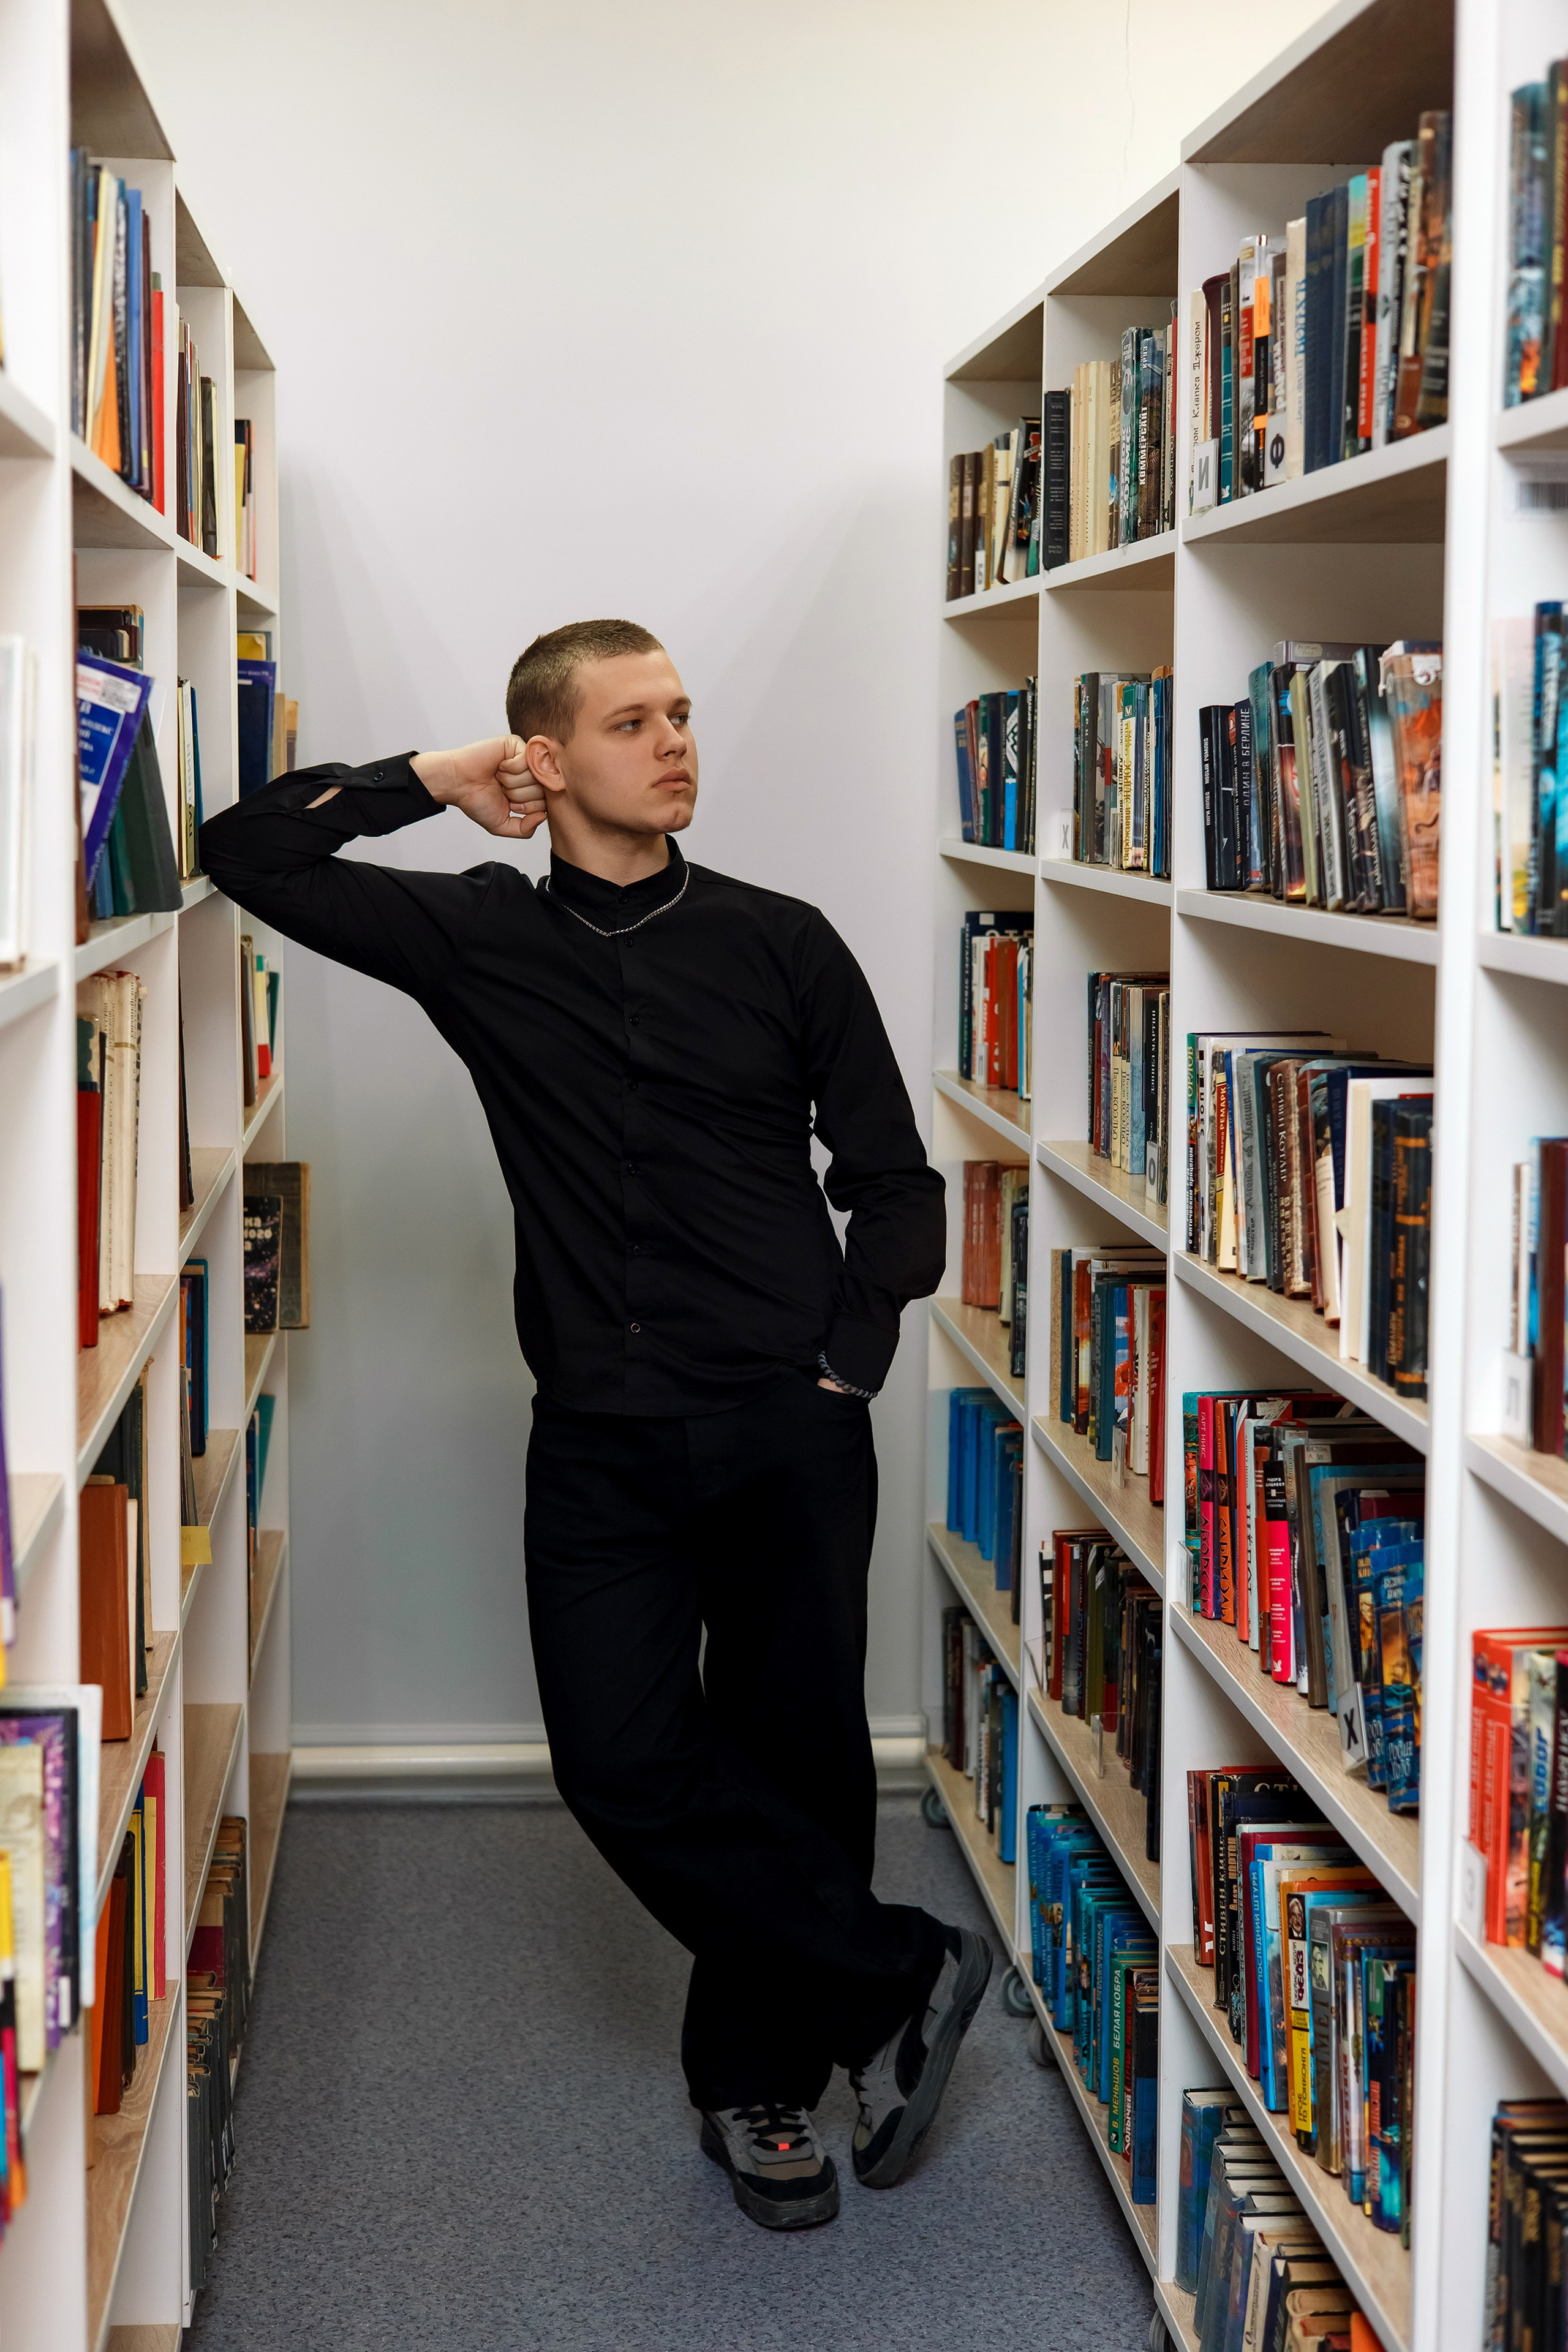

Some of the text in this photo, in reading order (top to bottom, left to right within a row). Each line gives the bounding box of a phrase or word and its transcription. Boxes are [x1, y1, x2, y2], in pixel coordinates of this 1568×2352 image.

[1192, 321, 1202, 418] Клапка Джером
[1139, 405, 1148, 484] КОММЕРСАНТ
[1197, 457, 1210, 491] И
[1240, 707, 1251, 757] БЕРЛИНЕ
[1123, 760, 1133, 804] ЭНДРЮС
[1276, 1072, 1287, 1182] СТИВЕН КОТЛЕР
[1219, 1518, 1232, 1618] САБРИЭЛЬ
[1343, 1708, 1359, 1751] Х
[1227, 1836, 1237, 1879] НОРТОН
[1218, 1888, 1227, 1956] СТИВЕН
[1251, 1872, 1264, 1982] ПОСЛЕДНИЙ ШТУРМ
[1112, 2118, 1119, 2129] В.
[1302, 2110, 1308, 2122] ИЗ
